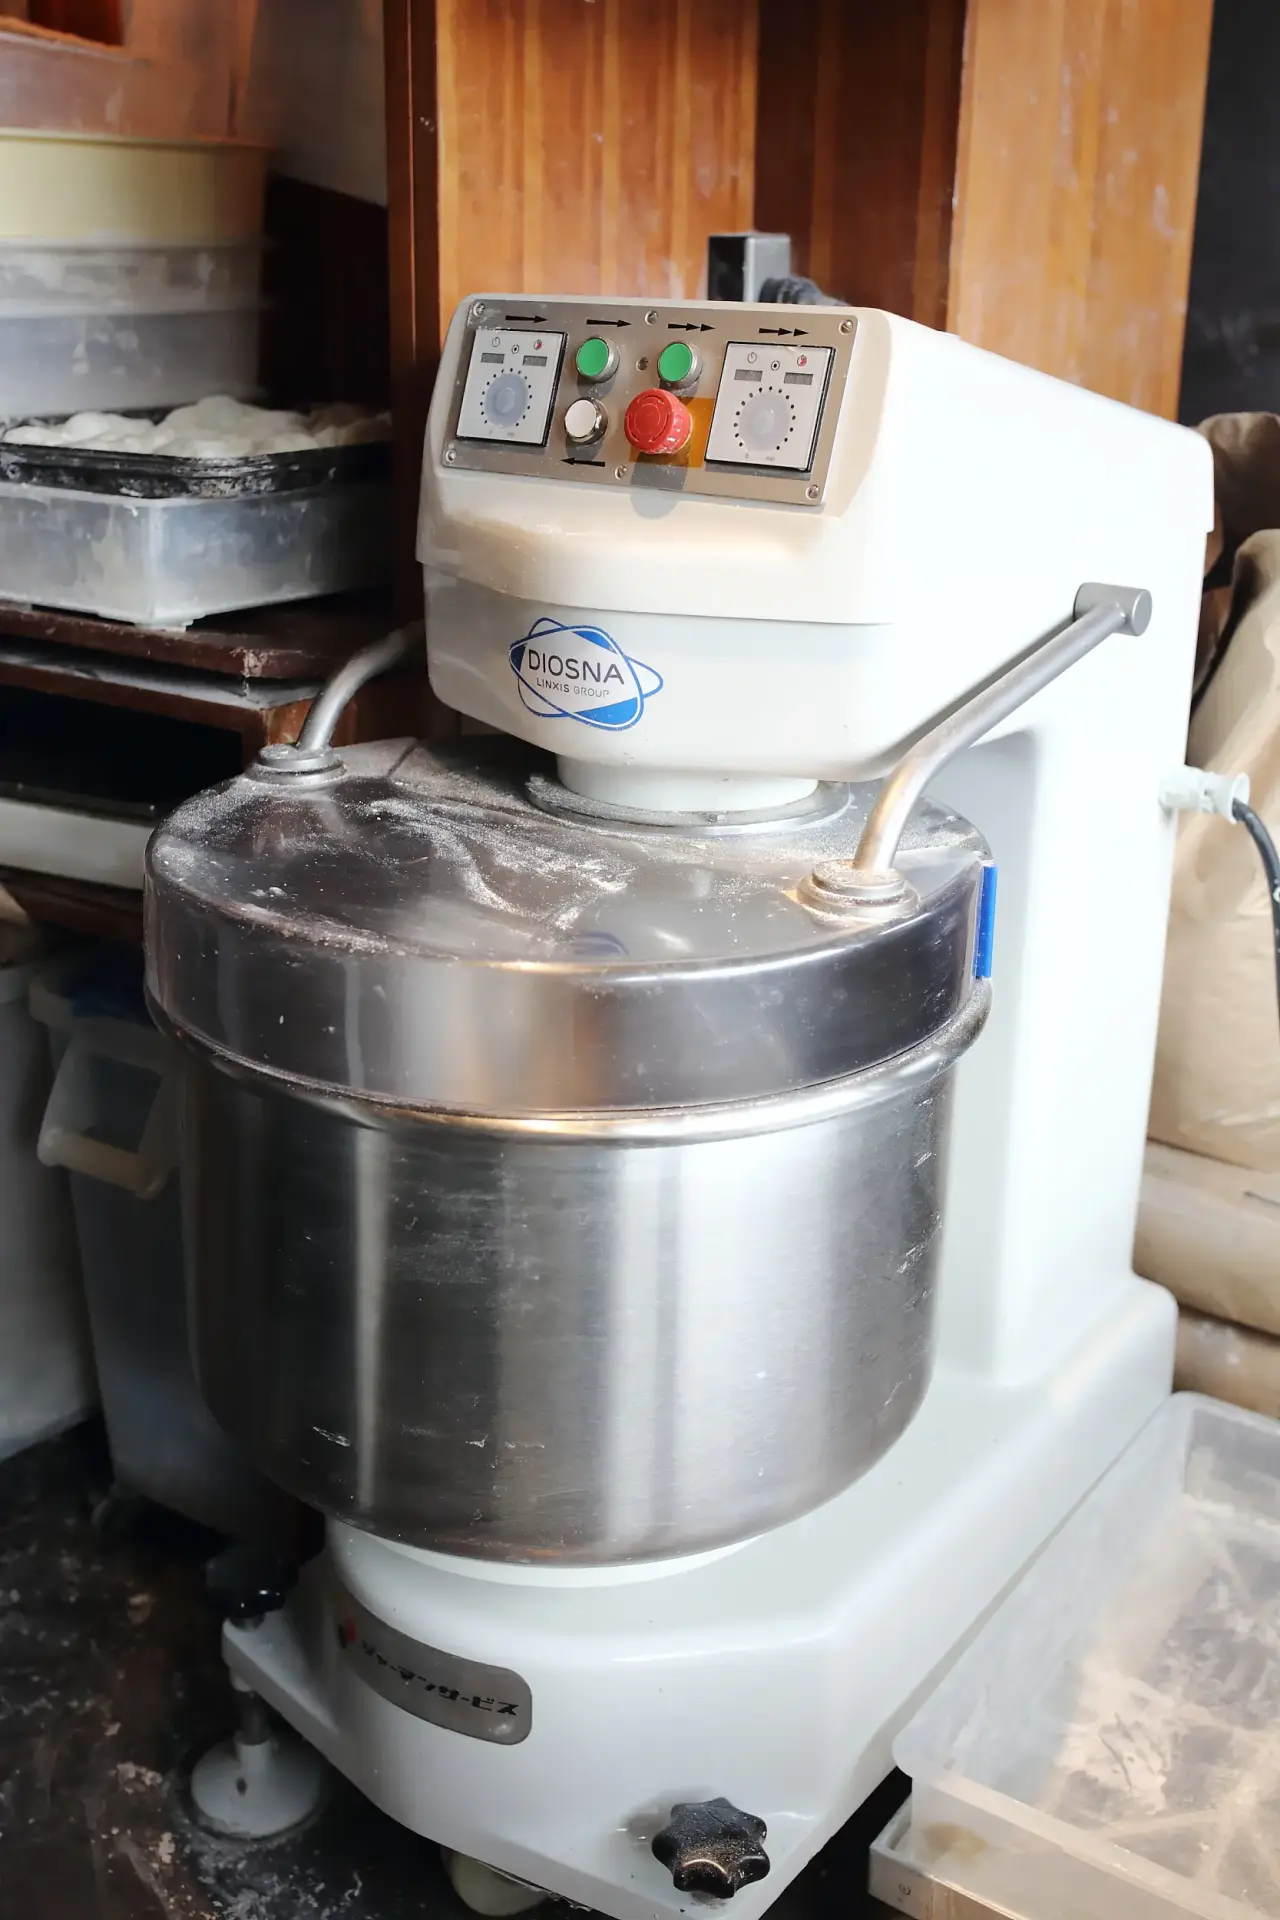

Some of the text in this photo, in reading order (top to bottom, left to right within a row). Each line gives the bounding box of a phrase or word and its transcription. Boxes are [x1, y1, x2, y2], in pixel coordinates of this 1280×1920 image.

[528, 649, 625, 685] DIOSNA
[536, 677, 610, 698] LINXIS GROUP
